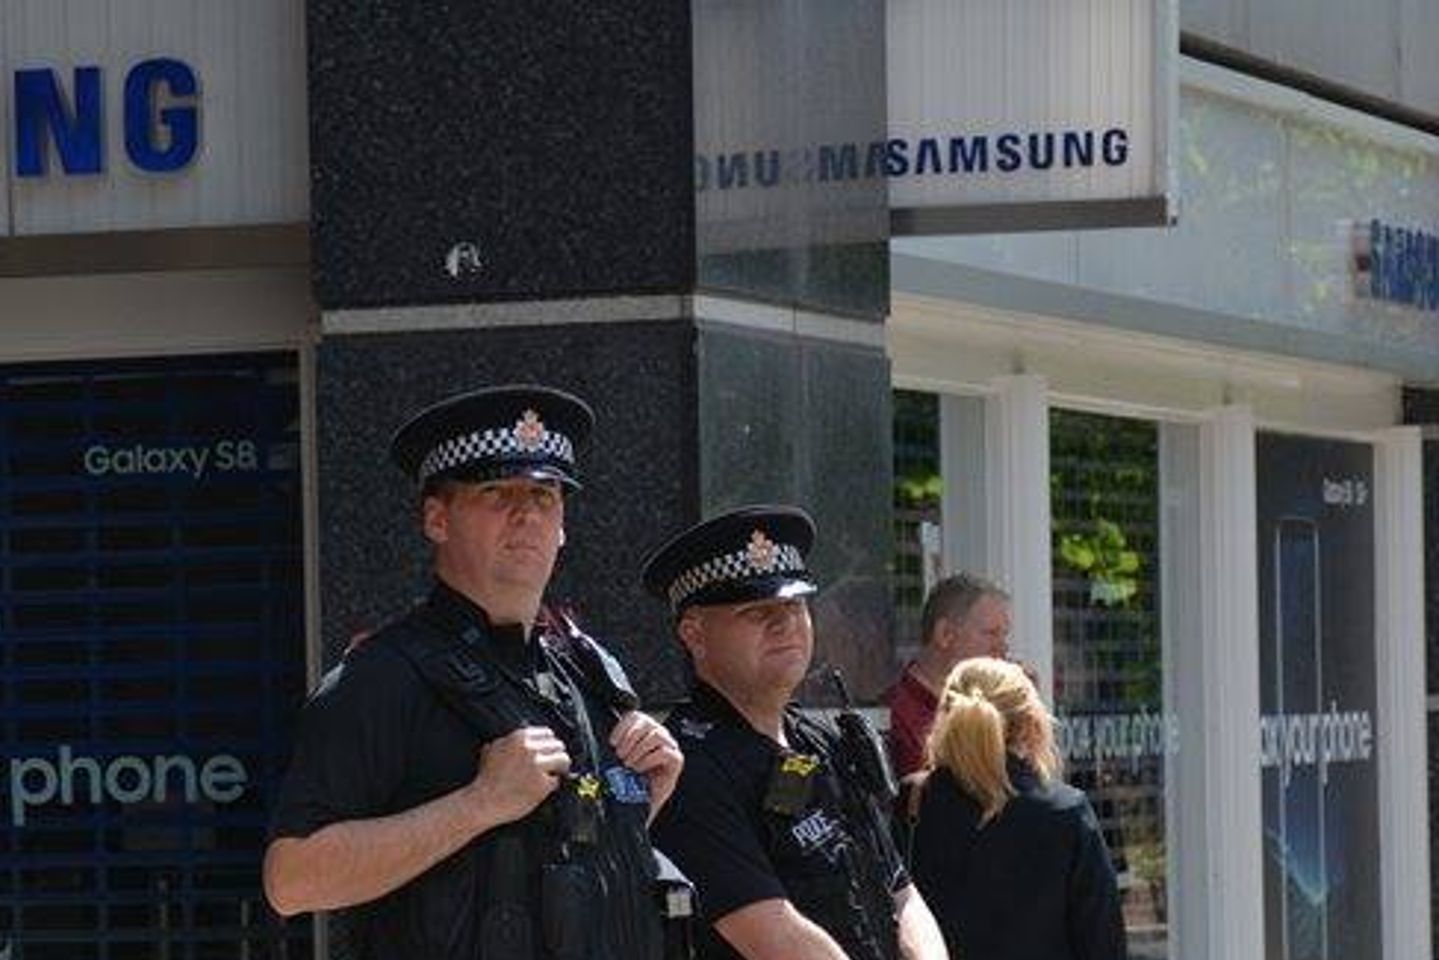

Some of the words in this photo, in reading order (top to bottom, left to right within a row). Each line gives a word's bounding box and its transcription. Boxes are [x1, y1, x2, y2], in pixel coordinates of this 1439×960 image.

[883, 128, 1128, 178] SAMSUNG
[84, 444, 208, 480] Galaxy
[214, 440, 258, 471] S8
[1321, 701, 1374, 785] phone
[11, 744, 248, 826] phone
